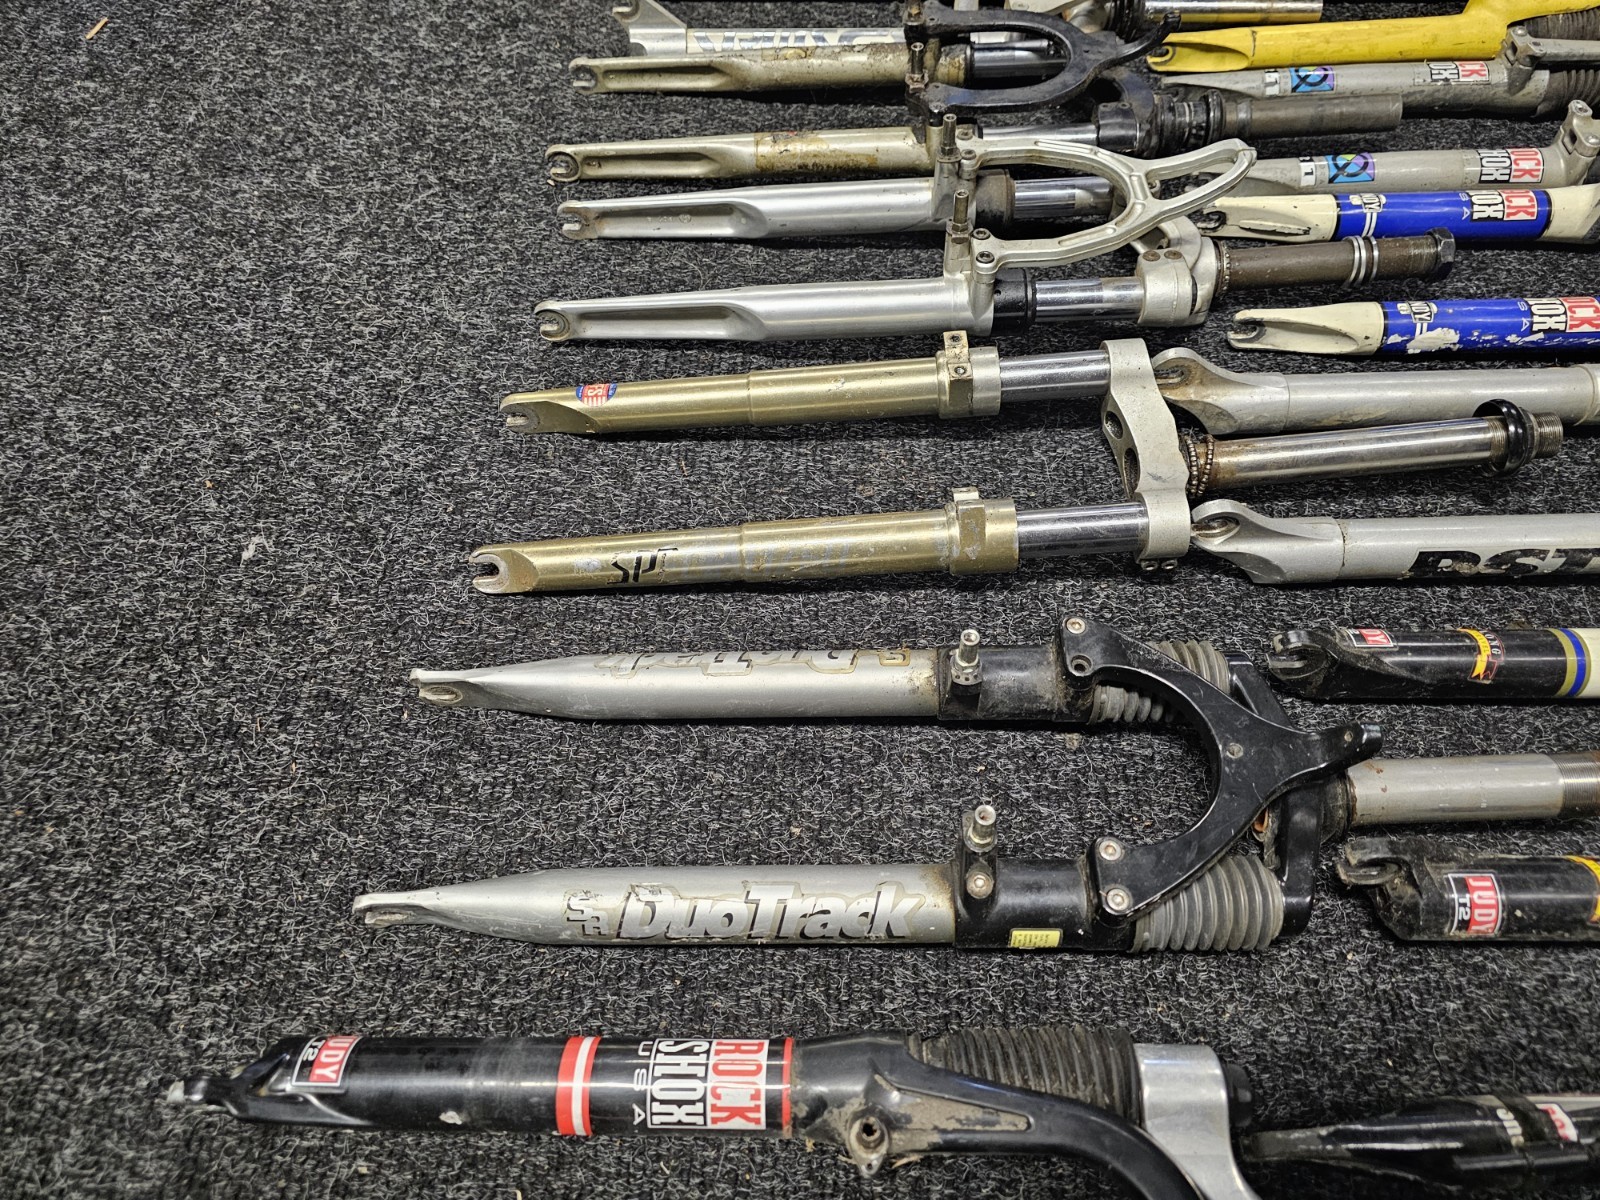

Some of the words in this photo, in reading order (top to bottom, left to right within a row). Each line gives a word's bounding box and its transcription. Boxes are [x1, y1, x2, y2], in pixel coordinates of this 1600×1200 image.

[1458, 62, 1488, 78] CK
[1477, 149, 1512, 181] HOX
[1509, 149, 1542, 179] OCK
[1361, 629, 1388, 644] DY
[616, 885, 913, 939] DuoTrack
[1458, 894, 1471, 921] T2
[1468, 878, 1498, 934] JUDY
[303, 1040, 327, 1061] T2
[314, 1036, 356, 1080] UDY
[651, 1040, 710, 1126] SHOX
[710, 1041, 765, 1126] ROCK
